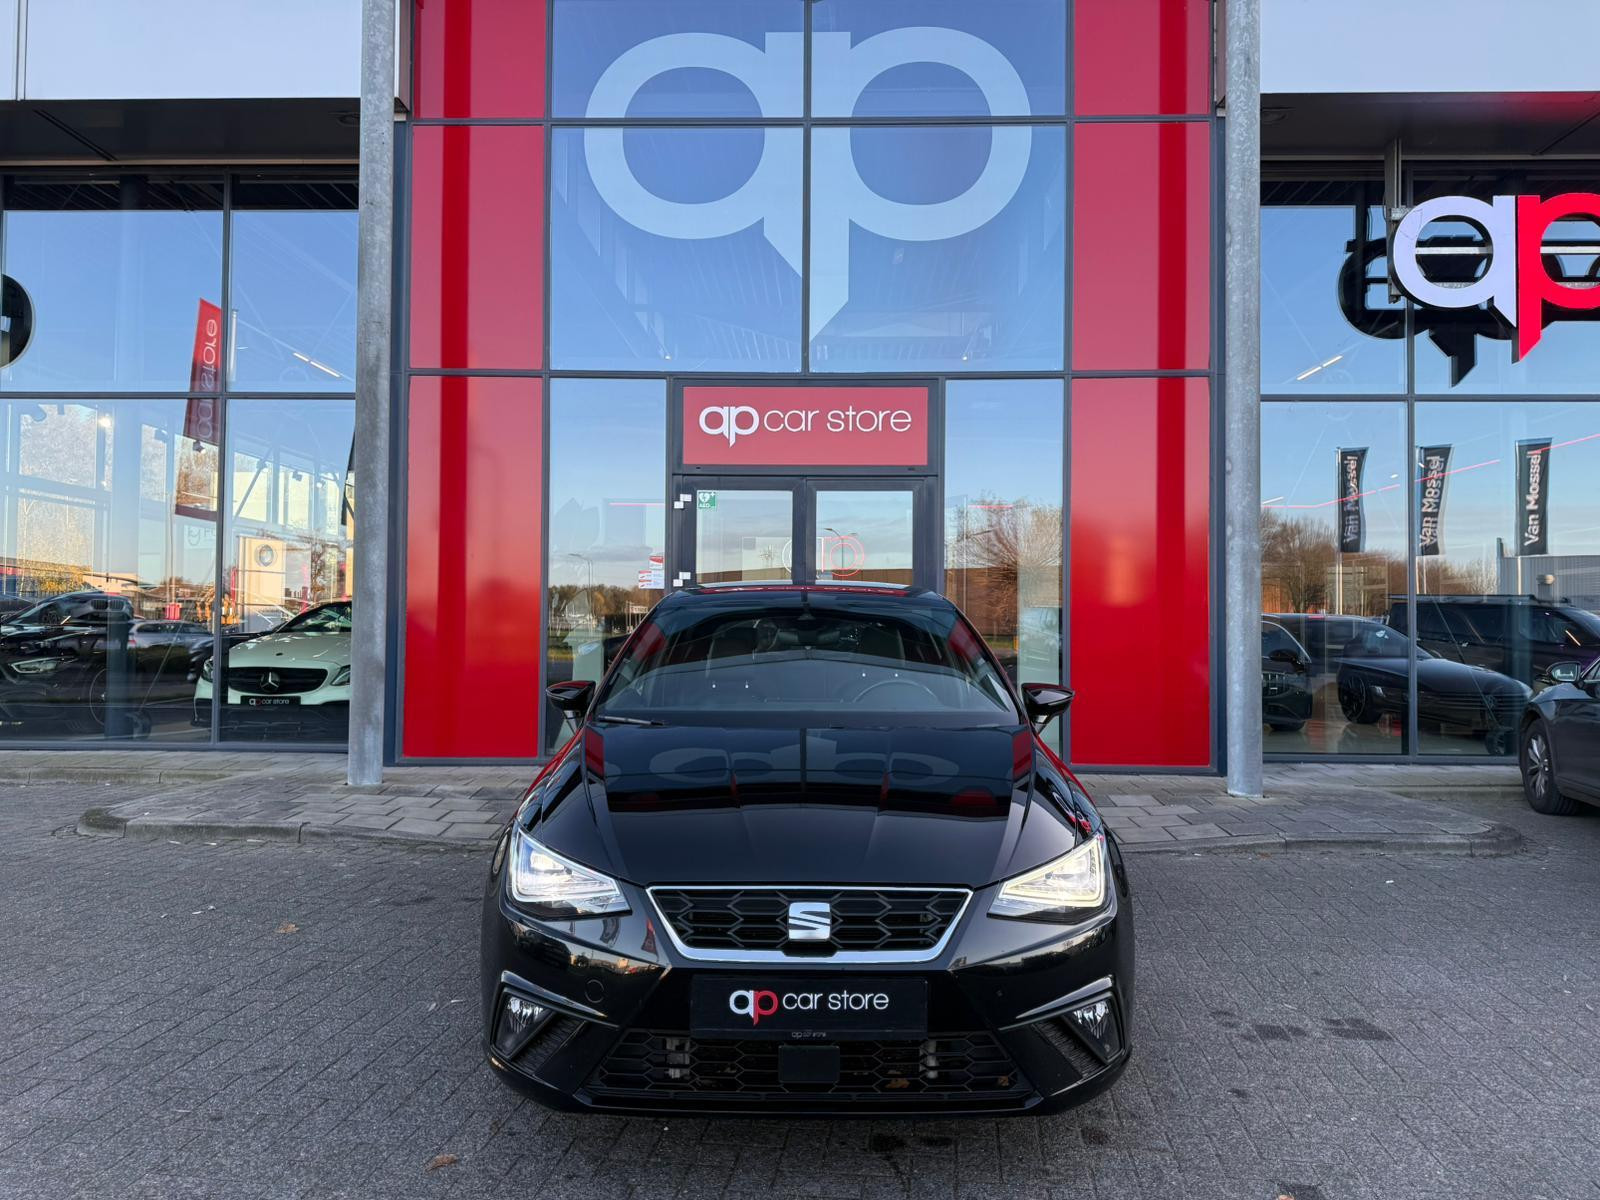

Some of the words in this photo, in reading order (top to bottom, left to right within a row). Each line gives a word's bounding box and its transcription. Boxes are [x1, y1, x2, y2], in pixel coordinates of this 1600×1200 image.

[584, 27, 1032, 342] ap
[1394, 192, 1600, 361] ap
[699, 406, 760, 448] ap
[763, 410, 820, 432] car
[826, 405, 912, 432] store
[1526, 451, 1542, 510] Mossel
[1524, 515, 1540, 546] Van
[729, 990, 779, 1026] ap
[782, 992, 823, 1010] car
[828, 989, 890, 1010] store
